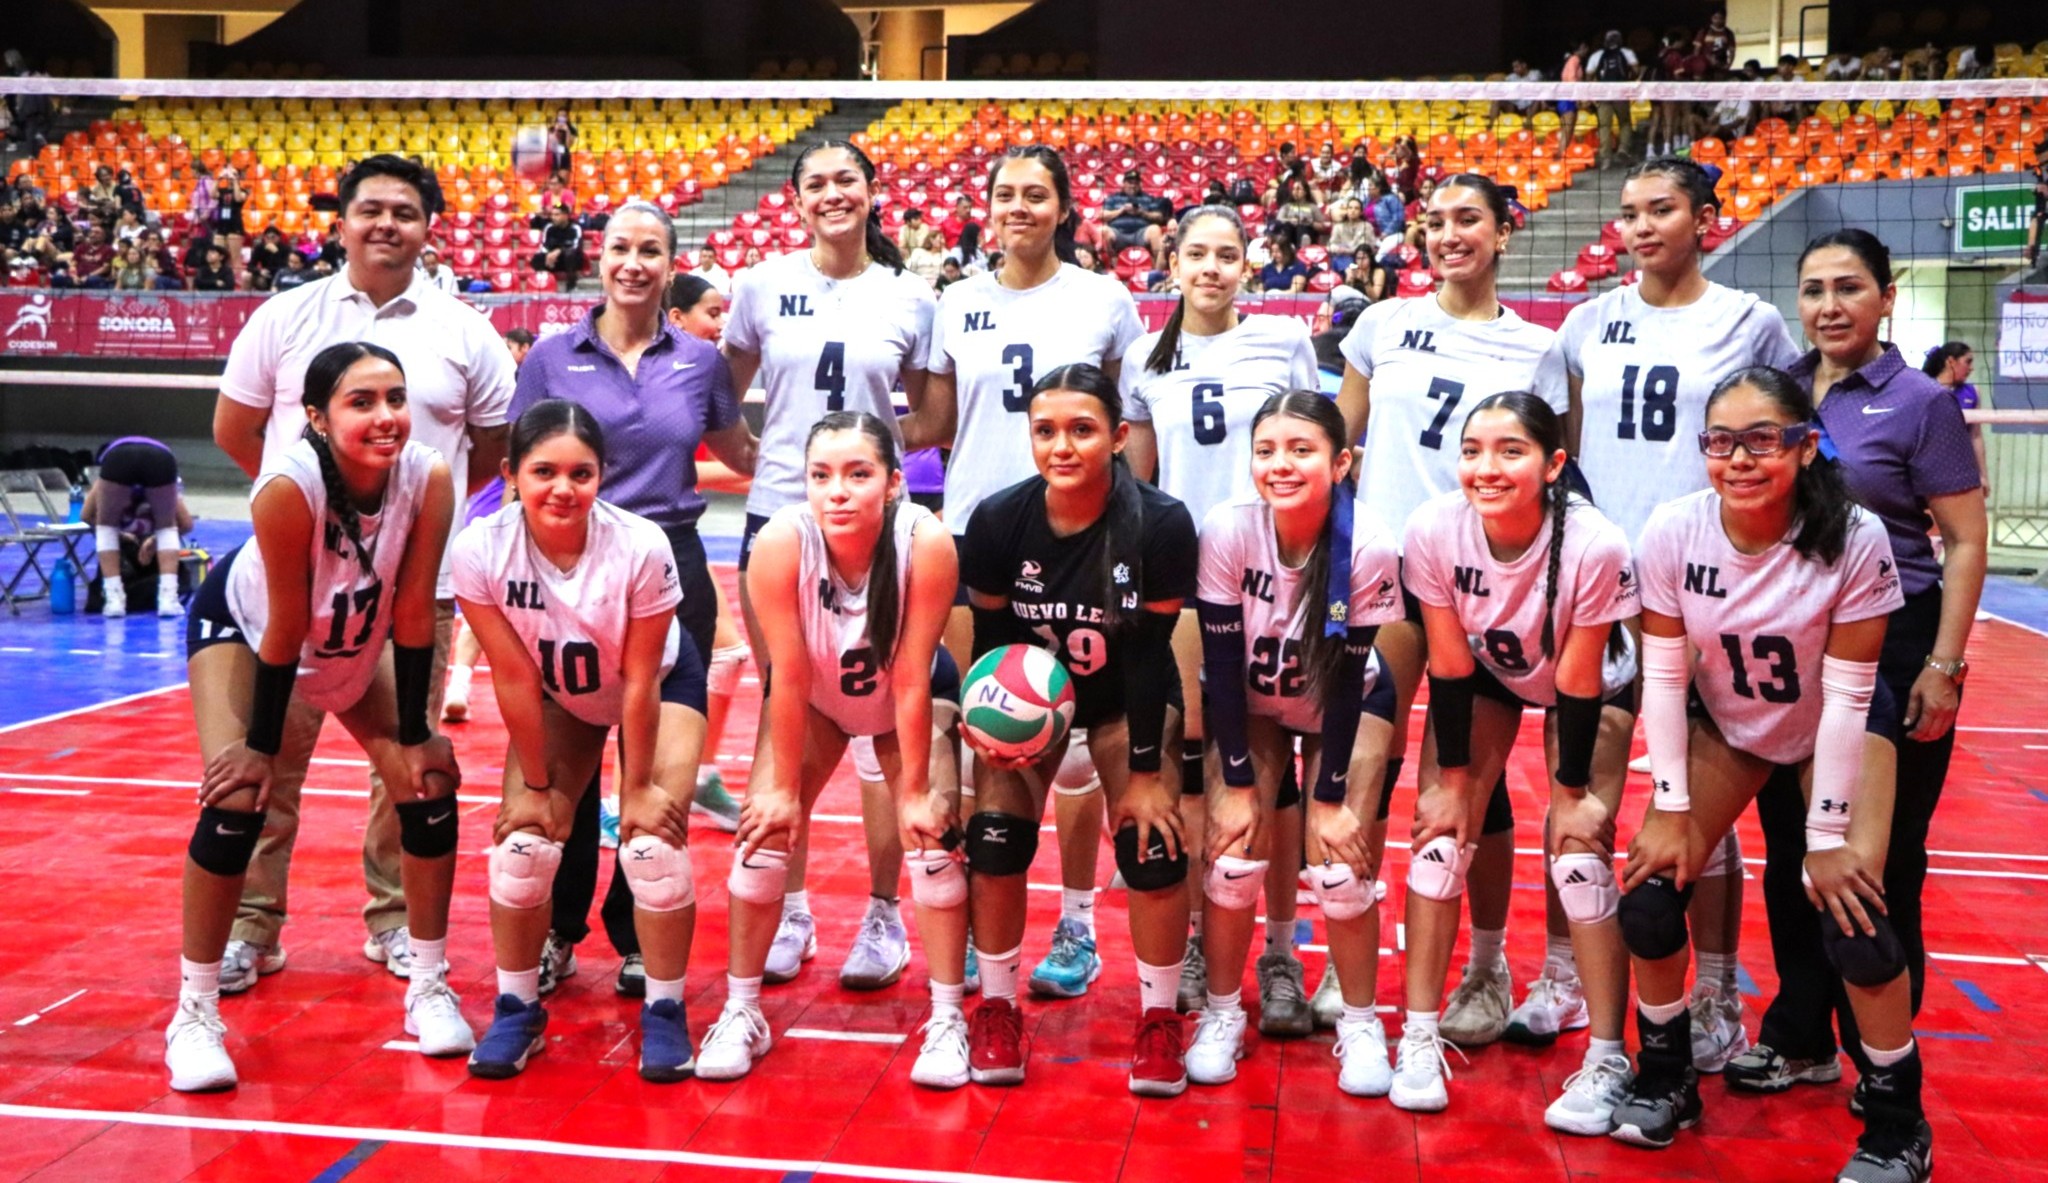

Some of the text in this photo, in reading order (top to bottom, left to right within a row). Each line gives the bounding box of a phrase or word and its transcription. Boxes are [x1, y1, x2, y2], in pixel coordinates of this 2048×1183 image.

[779, 294, 814, 316] NL
[963, 311, 996, 333] NL
[98, 316, 176, 332] SONORA
[1400, 329, 1436, 353] NL
[1601, 320, 1636, 344] NL
[814, 341, 846, 411] 4
[1002, 343, 1034, 412] 3
[1191, 383, 1227, 446] 6
[1419, 376, 1465, 451] 7
[1617, 365, 1680, 442] 18
[506, 580, 546, 610] NL
[1015, 581, 1043, 593] FMVB
[1241, 567, 1275, 604] NL
[1454, 565, 1490, 597] NL
[1684, 562, 1727, 598] NL
[323, 578, 382, 650] 17
[1205, 620, 1243, 634] NIKE
[538, 638, 601, 696] 10
[1249, 635, 1308, 698] 22
[1483, 628, 1529, 670] 8
[840, 647, 878, 697] 2
[1719, 633, 1801, 704] 13
[979, 683, 1015, 712] NL
